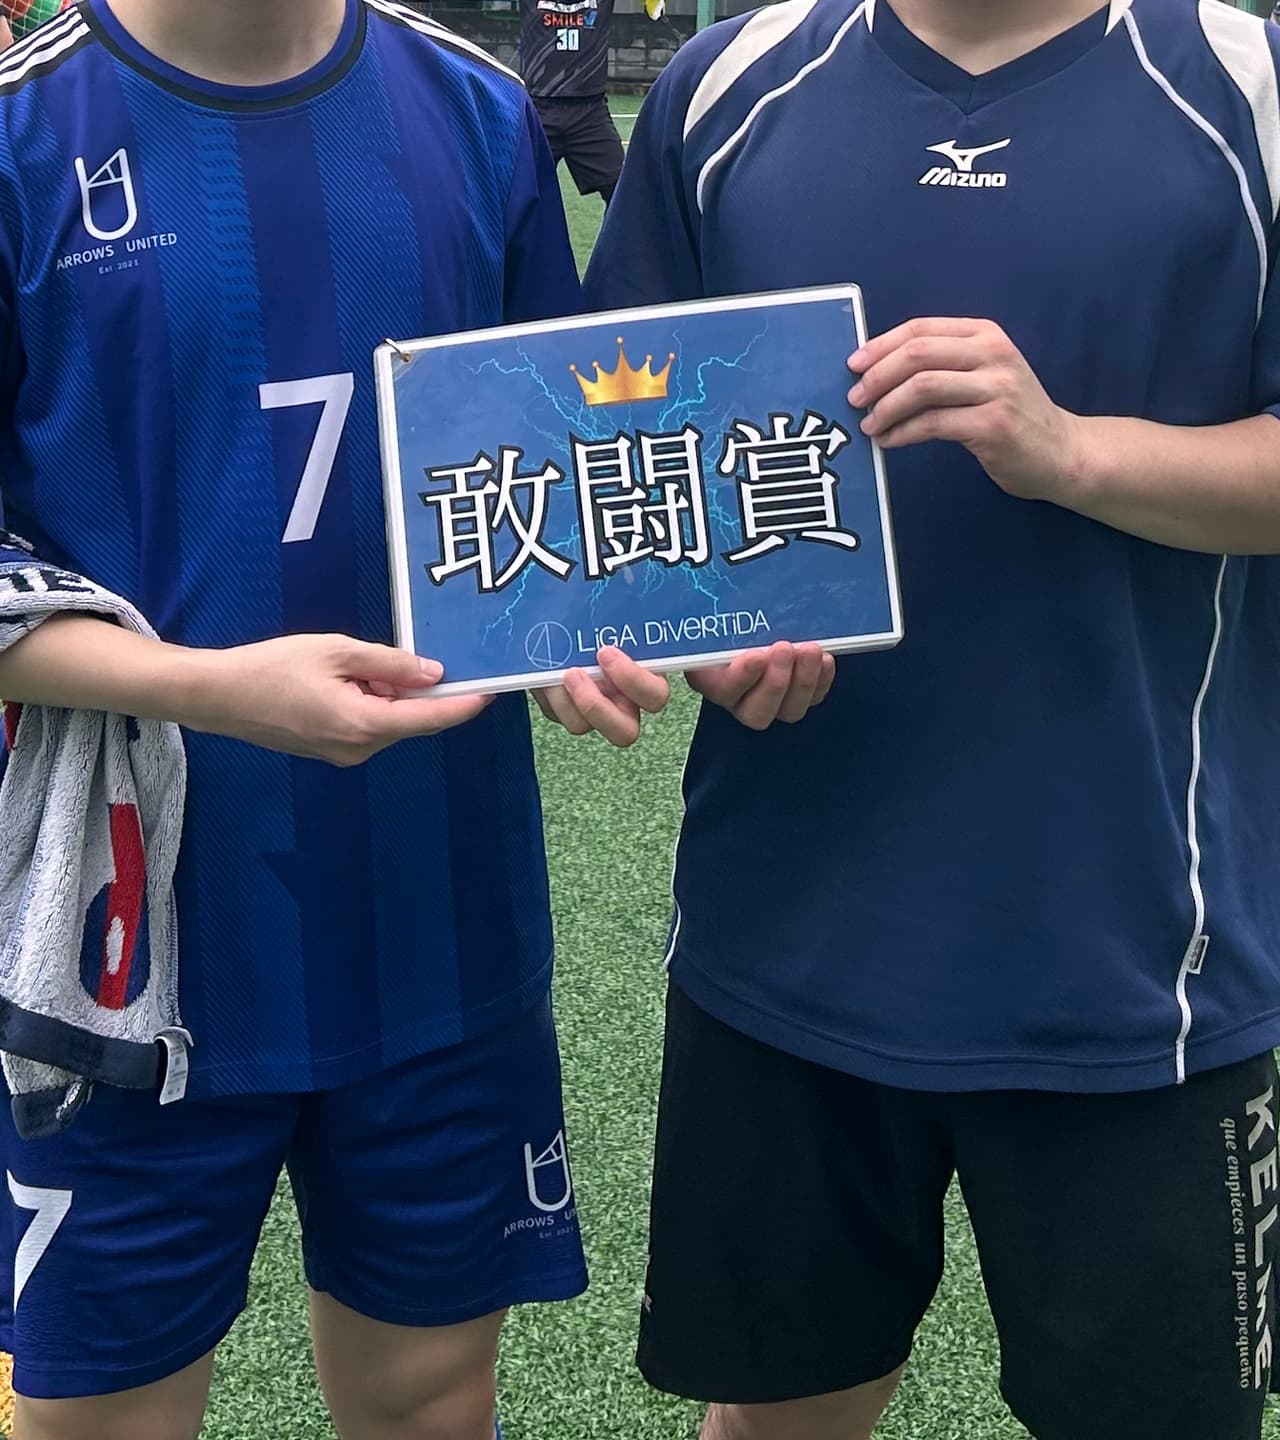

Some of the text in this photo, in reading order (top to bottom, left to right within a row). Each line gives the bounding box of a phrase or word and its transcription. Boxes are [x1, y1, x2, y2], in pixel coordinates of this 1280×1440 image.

[543, 13, 584, 26] SMILE
[556, 28, 579, 50] 30
[56, 232, 177, 271] ARROWS UNITED
[258, 372, 354, 543] 7
[421, 410, 861, 593] 敢闘賞
[6, 1167, 74, 1318] 7
[503, 1214, 555, 1239] ARROWS
[1219, 1116, 1253, 1389] que empieces un paso pequeño
[1245, 1084, 1279, 1390] KELME
